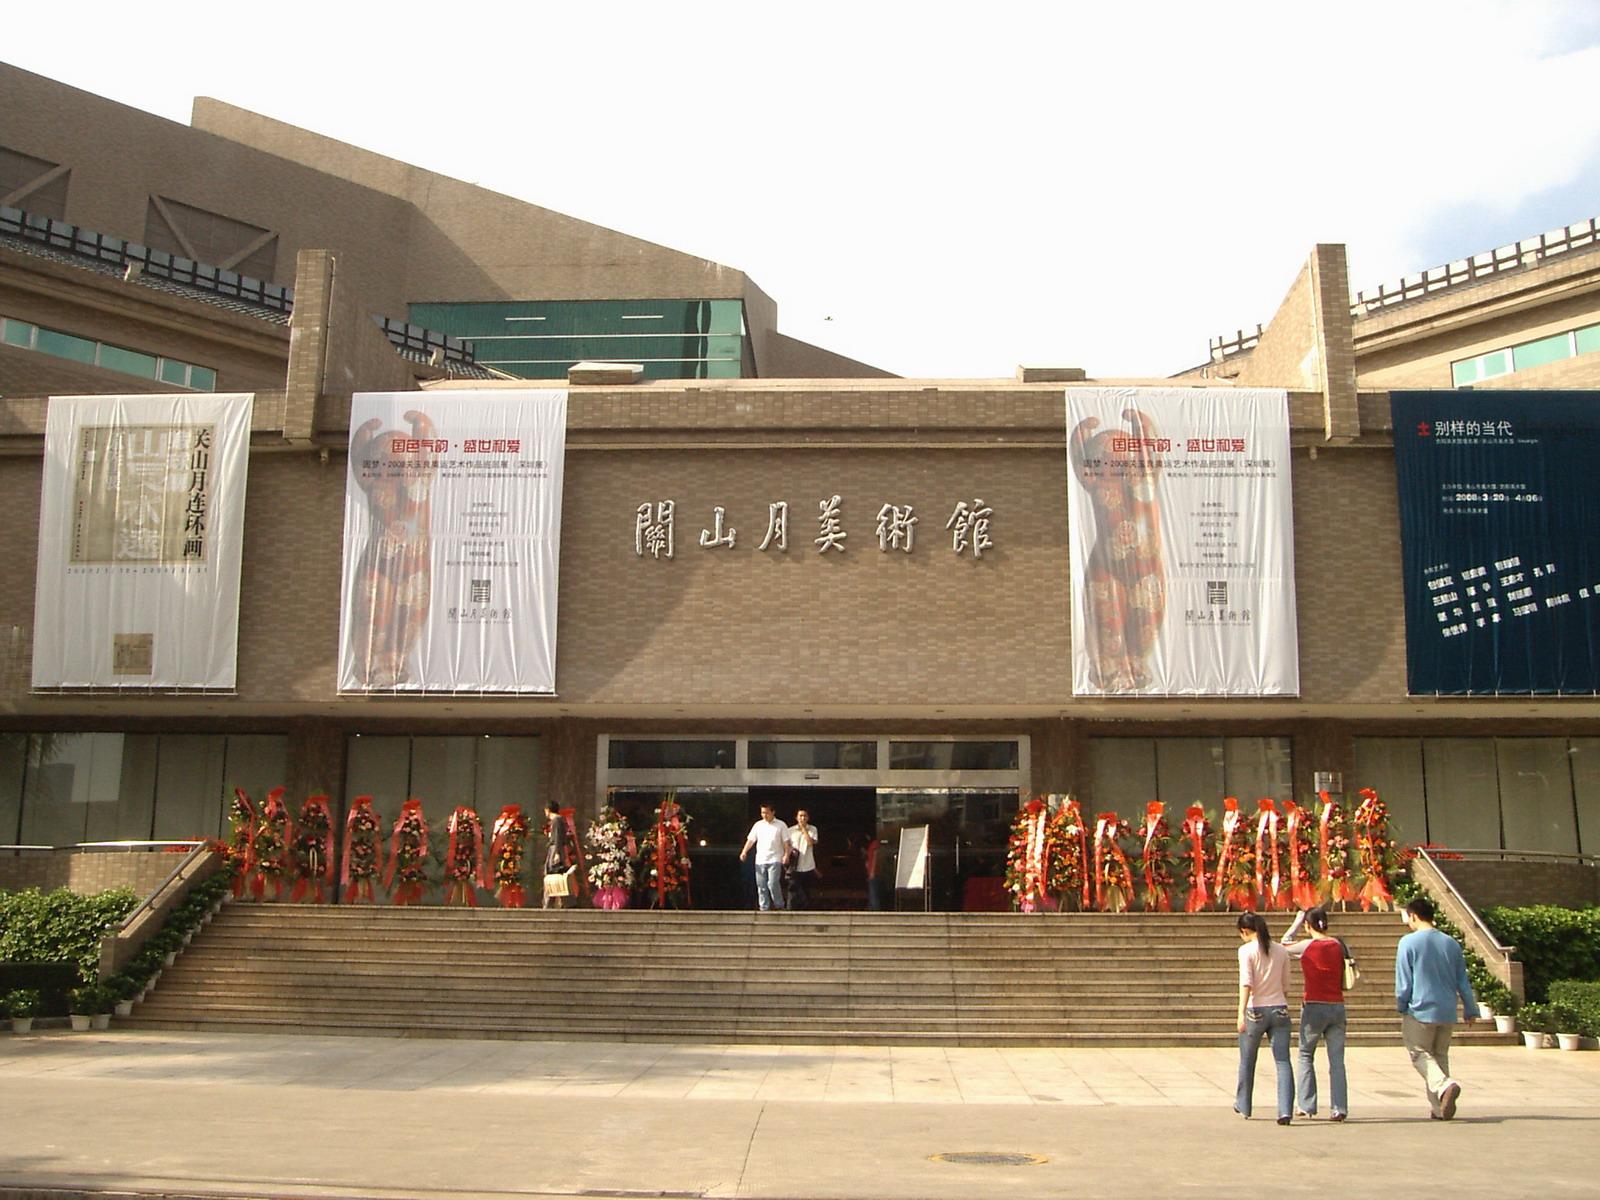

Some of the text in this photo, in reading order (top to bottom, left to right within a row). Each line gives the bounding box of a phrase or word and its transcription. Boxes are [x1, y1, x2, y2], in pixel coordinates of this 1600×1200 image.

[1435, 420, 1513, 436] 别样的当代
[183, 429, 210, 558] 关山月连环画
[635, 494, 994, 560] 關山月美術館
